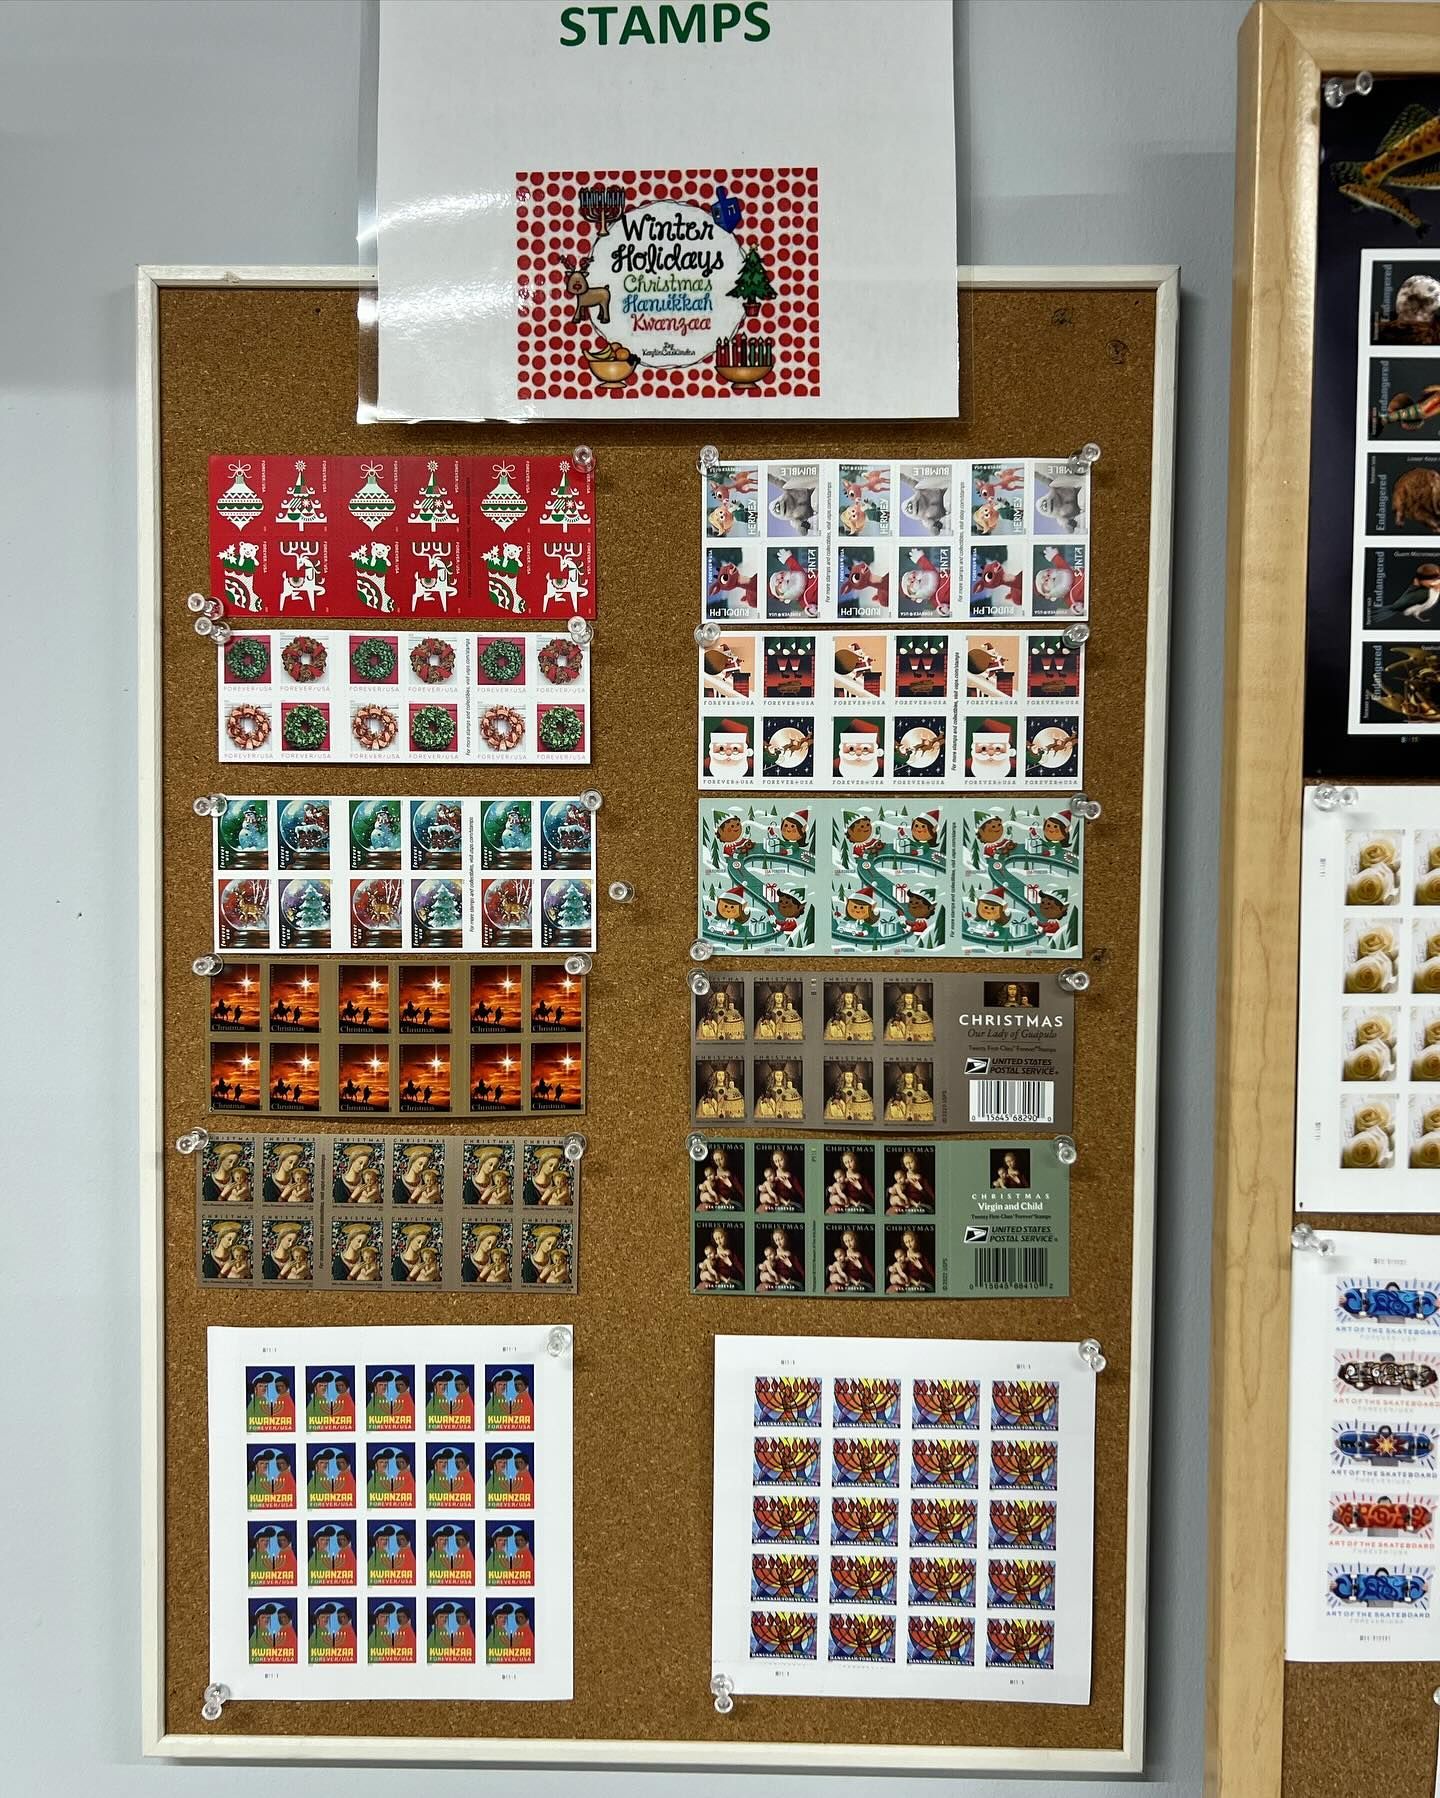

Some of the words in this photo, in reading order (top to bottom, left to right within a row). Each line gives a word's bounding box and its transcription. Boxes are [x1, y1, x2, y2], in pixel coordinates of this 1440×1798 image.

[560, 1, 770, 46] STAMPS
[622, 213, 713, 241] Winter
[611, 243, 724, 277] Holidays
[623, 274, 713, 293] Christmas
[623, 293, 713, 313] Hanukkah
[631, 314, 711, 336] Kwanzaa
[780, 467, 817, 476] BUMBLE
[913, 467, 950, 476] BUMBLE
[1376, 474, 1388, 531] Endangered
[748, 500, 757, 535] HERMEY
[879, 500, 888, 534] HERMEY
[1013, 497, 1022, 532] HERMEY
[808, 549, 817, 579] SANTA
[940, 549, 949, 579] SANTA
[1074, 547, 1083, 577] SANTA
[1373, 551, 1386, 608] Endangered
[709, 608, 750, 617] RUDOLPH
[840, 607, 881, 616] RUDOLPH
[973, 606, 1014, 615] RUDOLPH
[1371, 645, 1383, 701] Endangered
[958, 1014, 1063, 1027] CHRISTMAS
[967, 1029, 985, 1038] Our
[988, 1029, 1008, 1041] Lady
[1010, 1028, 1020, 1040] of
[1024, 1058, 1052, 1066] STATES
[990, 1066, 1019, 1075] POSTAL
[1013, 1114, 1038, 1122] 68290
[886, 1146, 935, 1154] CHRISTMAS
[978, 1202, 1004, 1212] Virgin
[1004, 1202, 1020, 1211] and
[1020, 1202, 1043, 1211] Child
[755, 1223, 804, 1231] CHRISTMAS
[825, 1224, 875, 1232] CHRISTMAS
[886, 1225, 935, 1233] CHRISTMAS
[249, 1416, 292, 1425] KWANZAA
[309, 1416, 352, 1425] KWANZAA
[368, 1416, 411, 1425] KWANZAA
[428, 1416, 471, 1425] KWANZAA
[487, 1416, 530, 1425] KWANZAA
[250, 1493, 293, 1502] KWANZAA
[310, 1493, 352, 1502] KWANZAA
[369, 1493, 412, 1502] KWANZAA
[429, 1493, 471, 1502] KWANZAA
[488, 1493, 530, 1502] KWANZAA
[250, 1570, 294, 1579] KWANZAA
[310, 1570, 353, 1579] KWANZAA
[370, 1570, 412, 1579] KWANZAA
[429, 1570, 472, 1579] KWANZAA
[488, 1570, 531, 1579] KWANZAA
[251, 1648, 294, 1657] KWANZAA
[310, 1648, 353, 1657] KWANZAA
[370, 1648, 413, 1657] KWANZAA
[429, 1648, 472, 1657] KWANZAA
[488, 1648, 531, 1657] KWANZAA
